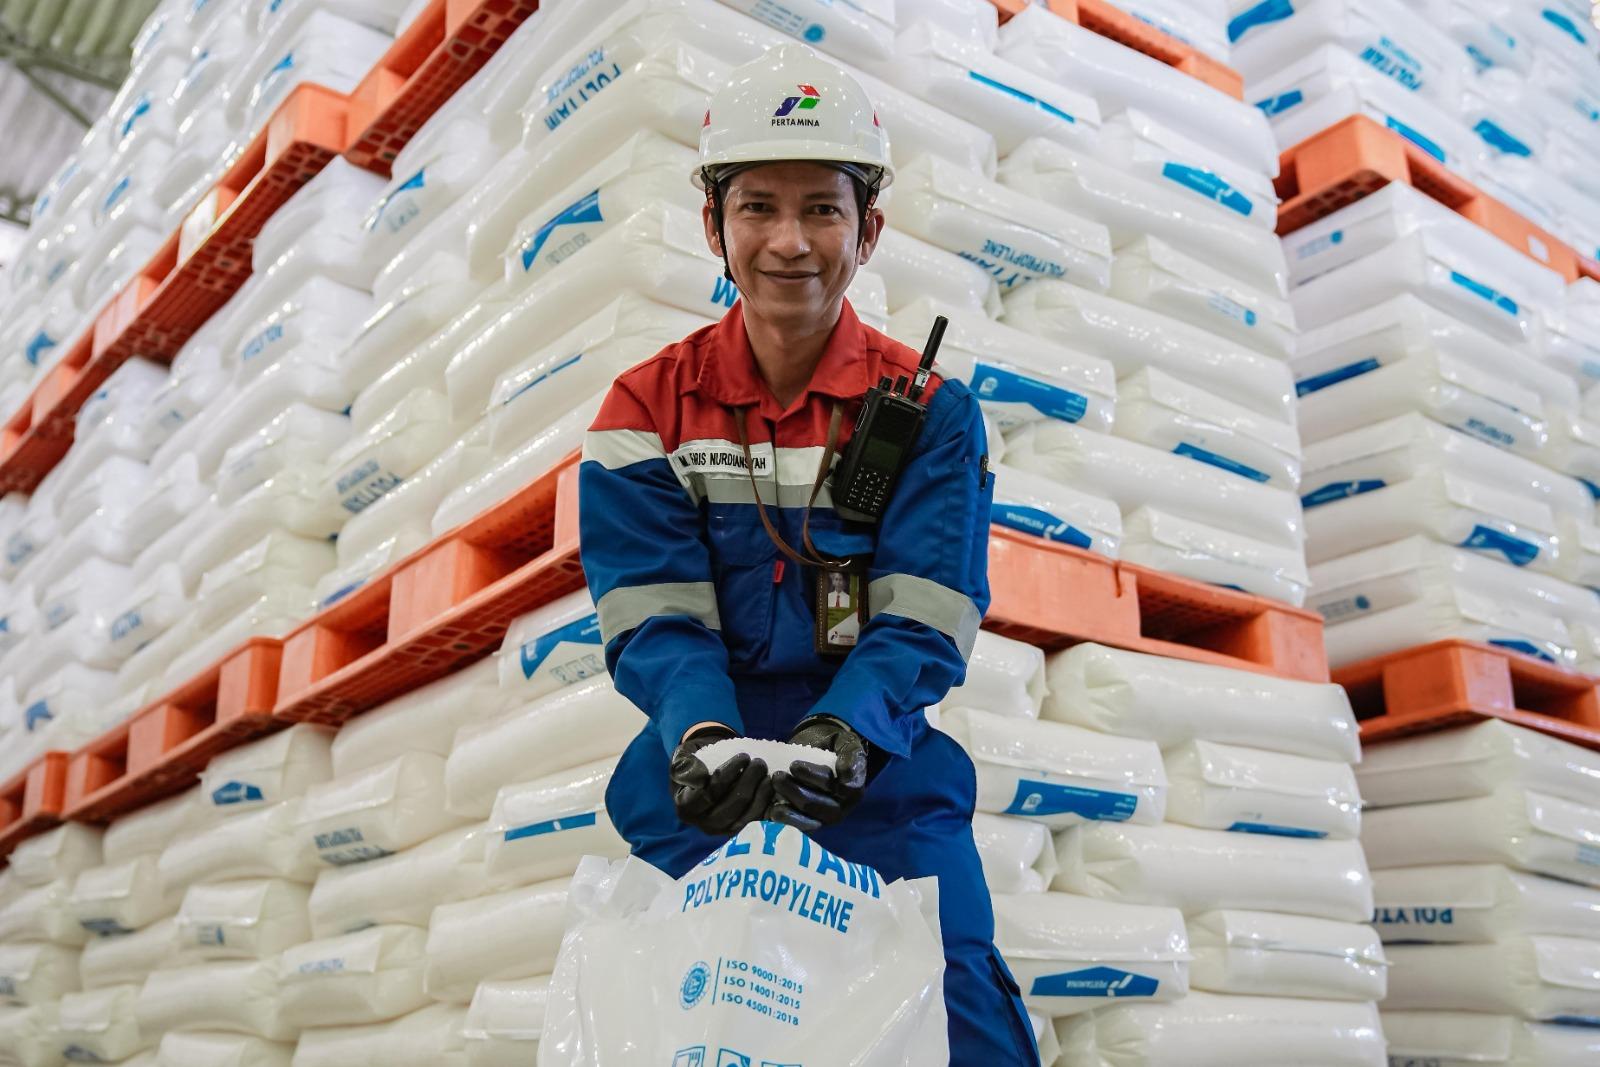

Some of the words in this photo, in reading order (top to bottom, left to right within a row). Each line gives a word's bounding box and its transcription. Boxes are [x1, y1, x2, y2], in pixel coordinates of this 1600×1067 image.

[771, 118, 820, 127] PERTAMINA
[682, 868, 854, 933] POLYPROPYLENE
[724, 976, 746, 987] ISO
[750, 981, 800, 1010] 14001:2015
[727, 960, 748, 971] ISO
[751, 965, 803, 994] 90001:2015
[721, 991, 743, 1004] ISO
[746, 999, 799, 1026] 45001:2018
